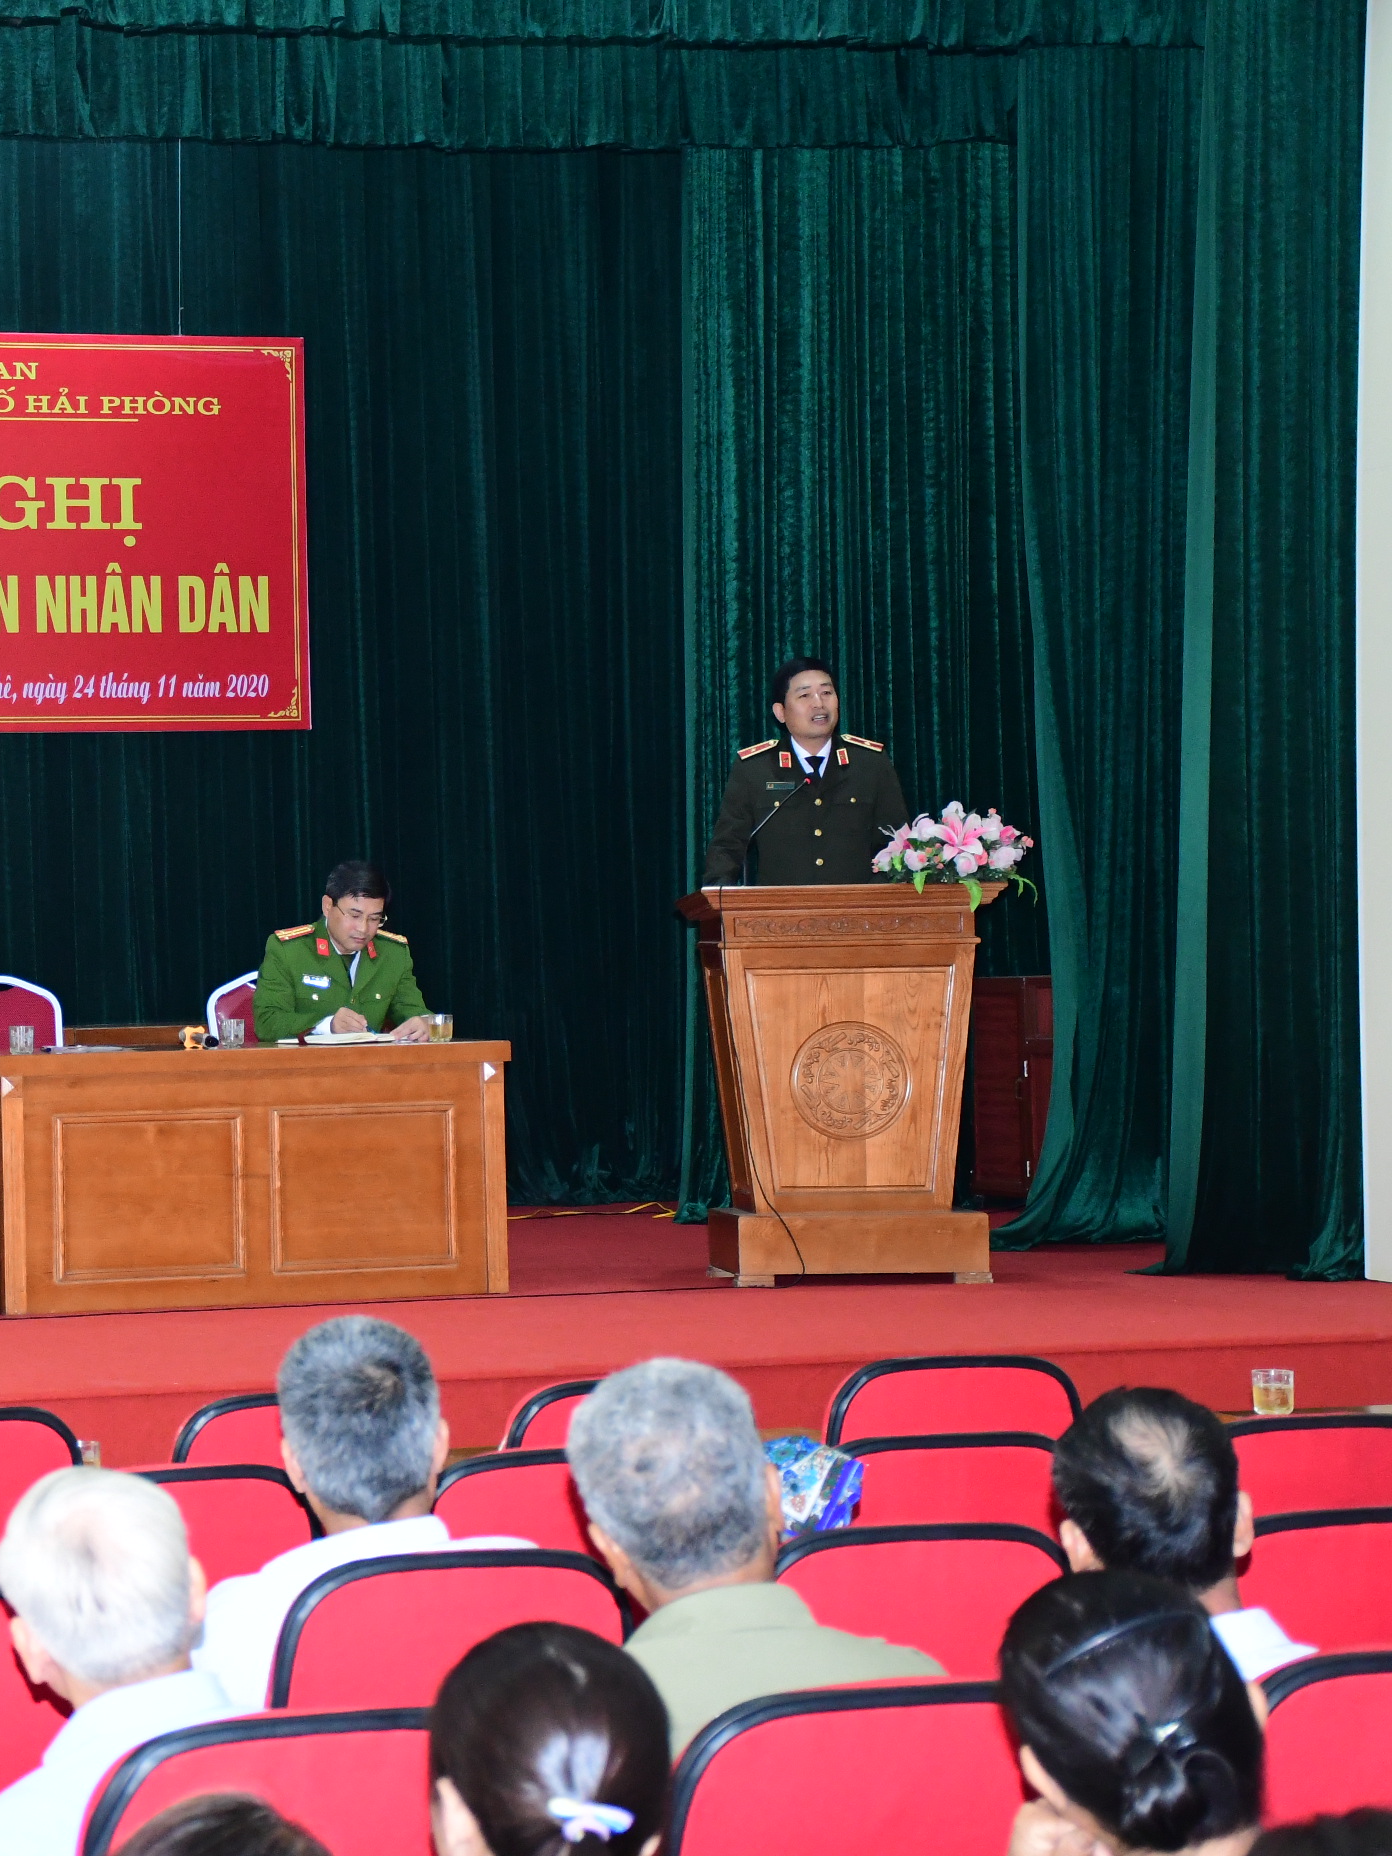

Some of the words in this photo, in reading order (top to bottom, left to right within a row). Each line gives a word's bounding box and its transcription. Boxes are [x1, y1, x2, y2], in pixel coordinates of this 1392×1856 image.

[24, 387, 89, 414] HẢI
[99, 390, 222, 416] PHÒNG
[35, 562, 163, 634] NHÂN
[177, 562, 270, 633] DÂN
[22, 674, 69, 706] ngày
[73, 674, 95, 699] 24
[99, 671, 151, 705] tháng
[157, 674, 177, 698] 11
[182, 672, 221, 698] năm
[225, 674, 269, 698] 2020
